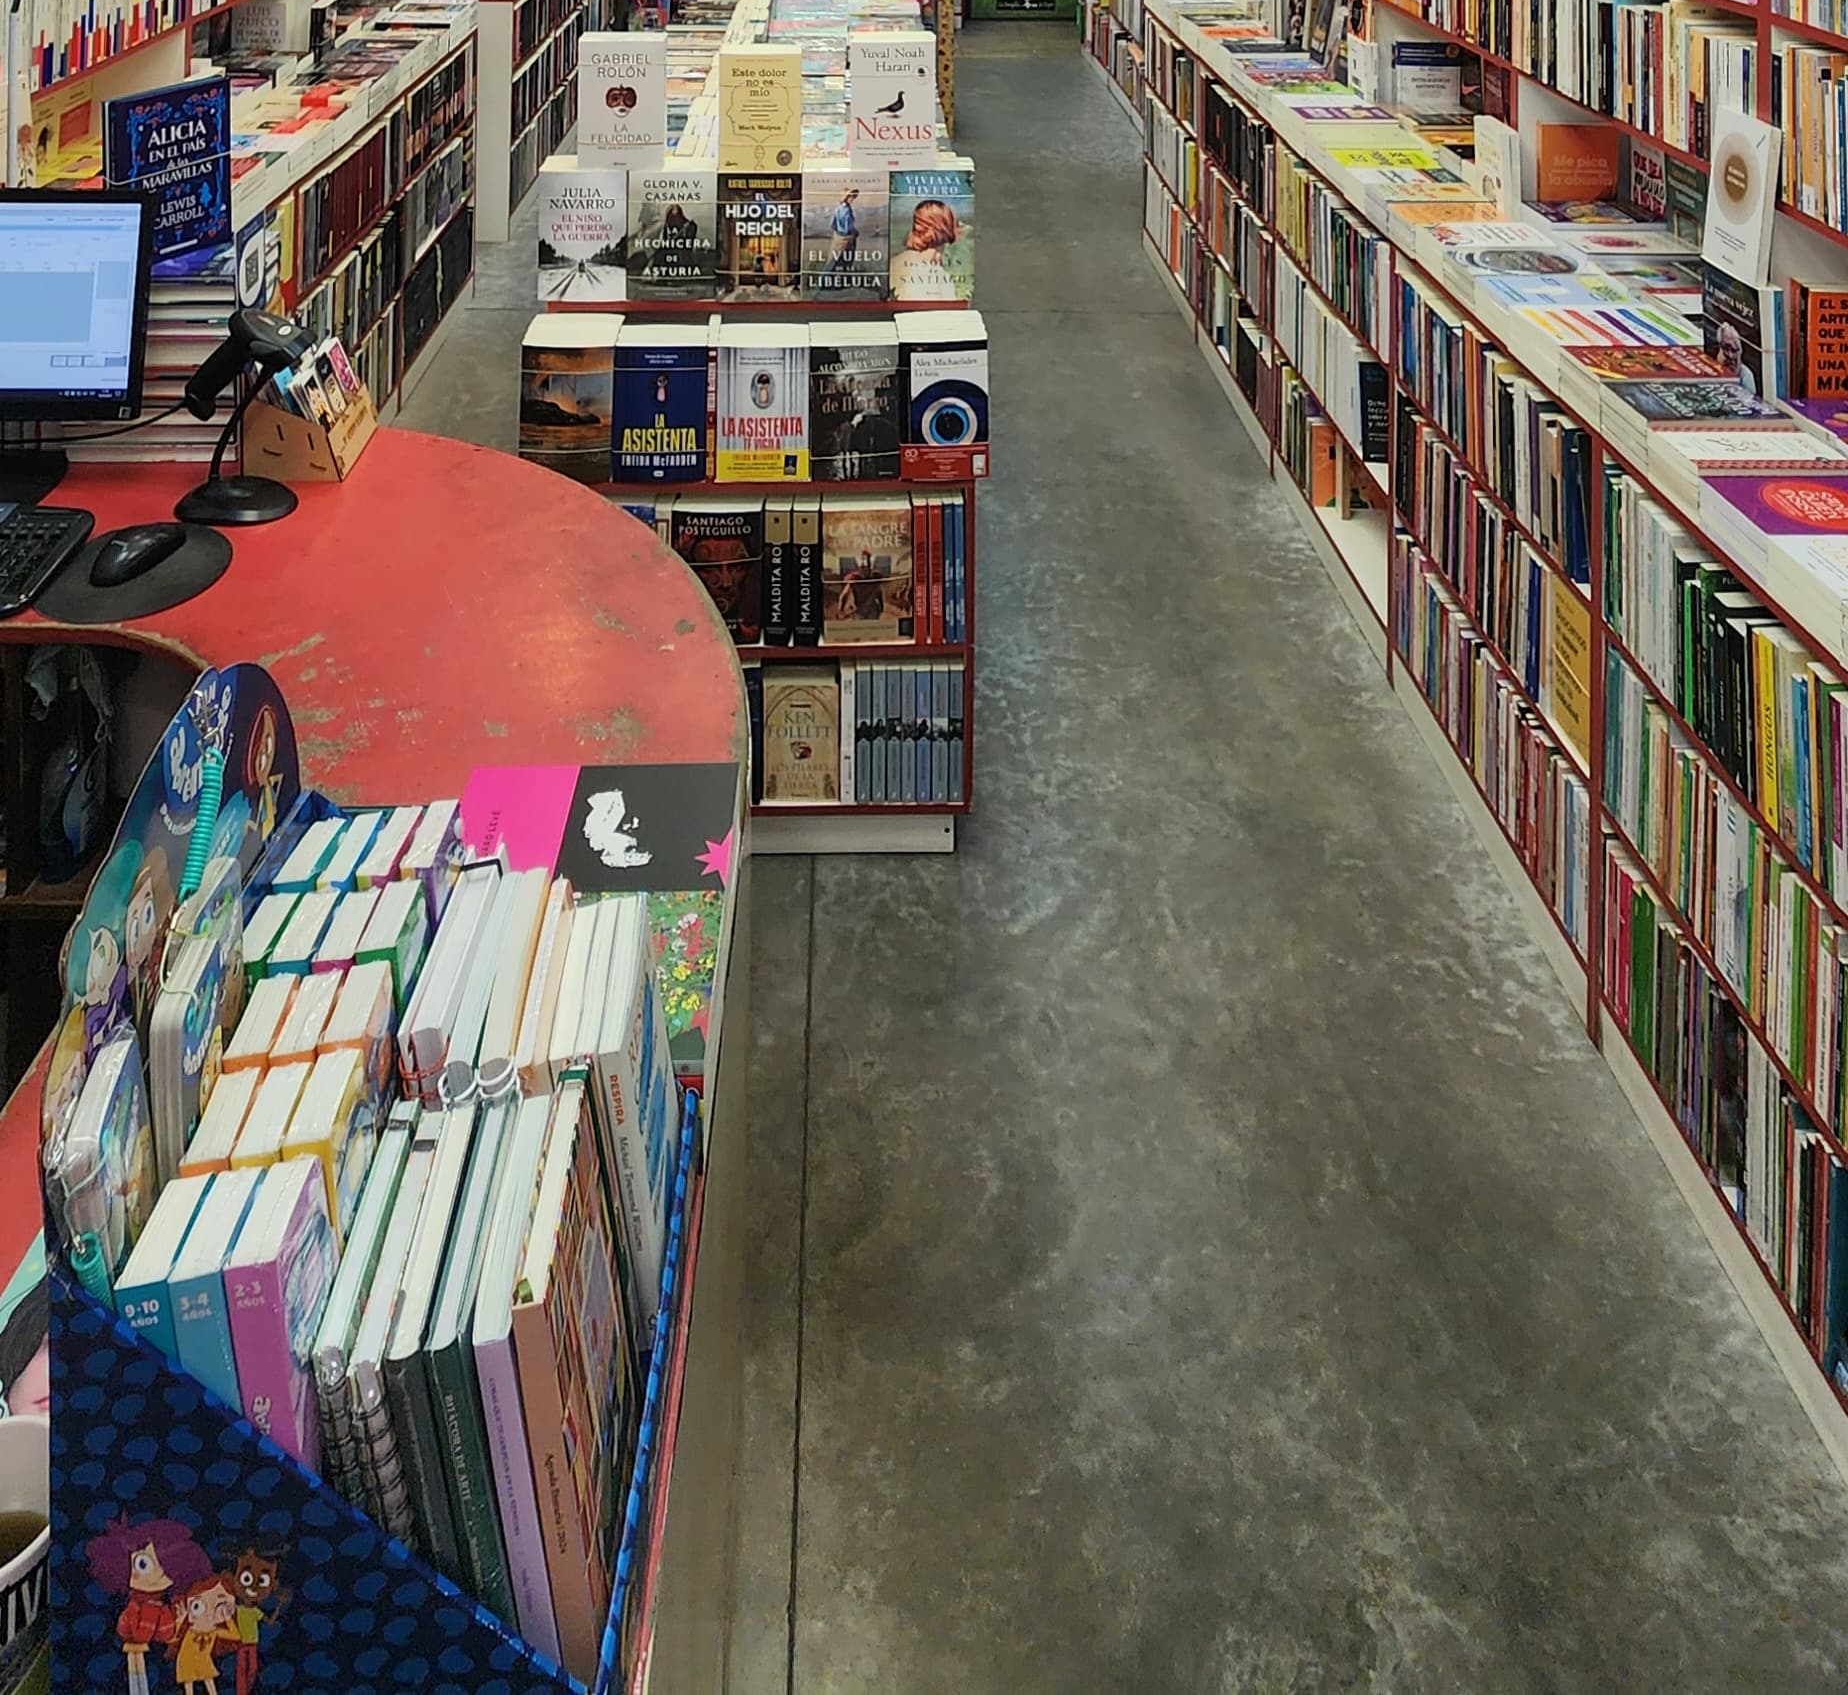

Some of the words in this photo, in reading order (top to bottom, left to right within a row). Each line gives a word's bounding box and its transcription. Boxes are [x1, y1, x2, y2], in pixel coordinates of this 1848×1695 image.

[591, 53, 651, 65] GABRIEL
[861, 47, 891, 60] Yuval
[894, 46, 925, 58] Noah
[597, 65, 646, 78] ROLÓN
[731, 68, 757, 78] Este
[758, 67, 787, 78] dolor
[875, 61, 911, 73] Harari
[745, 80, 760, 88] no
[762, 80, 774, 88] es
[749, 87, 770, 97] mío
[147, 119, 208, 149] ALICIA
[613, 124, 628, 133] LA
[855, 117, 933, 141] Nexus
[591, 134, 652, 143] FELICIDAD
[148, 147, 166, 164] EN
[167, 144, 181, 159] EL
[182, 137, 207, 156] PAÍS
[1577, 156, 1608, 169] pica
[142, 160, 213, 191] MARAVILLAS
[904, 175, 962, 185] VIVIANA
[643, 179, 689, 189] GLORIA
[692, 179, 703, 189] V.
[908, 185, 959, 195] RIVERO
[561, 187, 602, 198] JULIA
[755, 192, 766, 201] EL
[160, 194, 197, 216] LEWIS
[549, 198, 616, 210] NAVARRO
[561, 214, 573, 223] EL
[574, 212, 603, 223] NIÑO
[725, 204, 763, 219] HIJO
[765, 204, 795, 219] DEL
[153, 205, 206, 231] CARROLL
[551, 223, 573, 233] QUE
[667, 226, 678, 235] LA
[735, 221, 784, 236] REICH
[553, 233, 568, 242] LA
[568, 232, 611, 242] GUERRA
[634, 238, 711, 249] HECHICERA
[666, 255, 678, 263] DE
[808, 250, 826, 263] EL
[831, 250, 883, 262] VUELO
[642, 266, 702, 277] ASTURIA
[808, 273, 882, 288] LIBÉLULA
[900, 273, 967, 285] SANTIAGO
[1819, 298, 1836, 309] EL
[1818, 328, 1845, 339] QUE
[1817, 343, 1835, 354] TE
[915, 358, 934, 367] Alex
[1817, 359, 1846, 371] UNA
[822, 397, 839, 413] de
[654, 413, 665, 428] LA
[722, 418, 736, 437] LA
[738, 416, 803, 438] ASISTENTA
[622, 427, 697, 453] ASISTENTA
[686, 516, 745, 526] SANTIAGO
[679, 525, 752, 536] POSTEGUILLO
[828, 524, 845, 537] LA
[850, 521, 908, 536] SANGRE
[852, 534, 903, 548] PADRE
[771, 566, 783, 623] MALDITA
[800, 566, 811, 623] MALDITA
[784, 710, 816, 724] KEN
[768, 725, 832, 739] FOLLETT
[1764, 703, 1775, 781] HONGOS
[609, 1074, 625, 1127] RESPIRA
